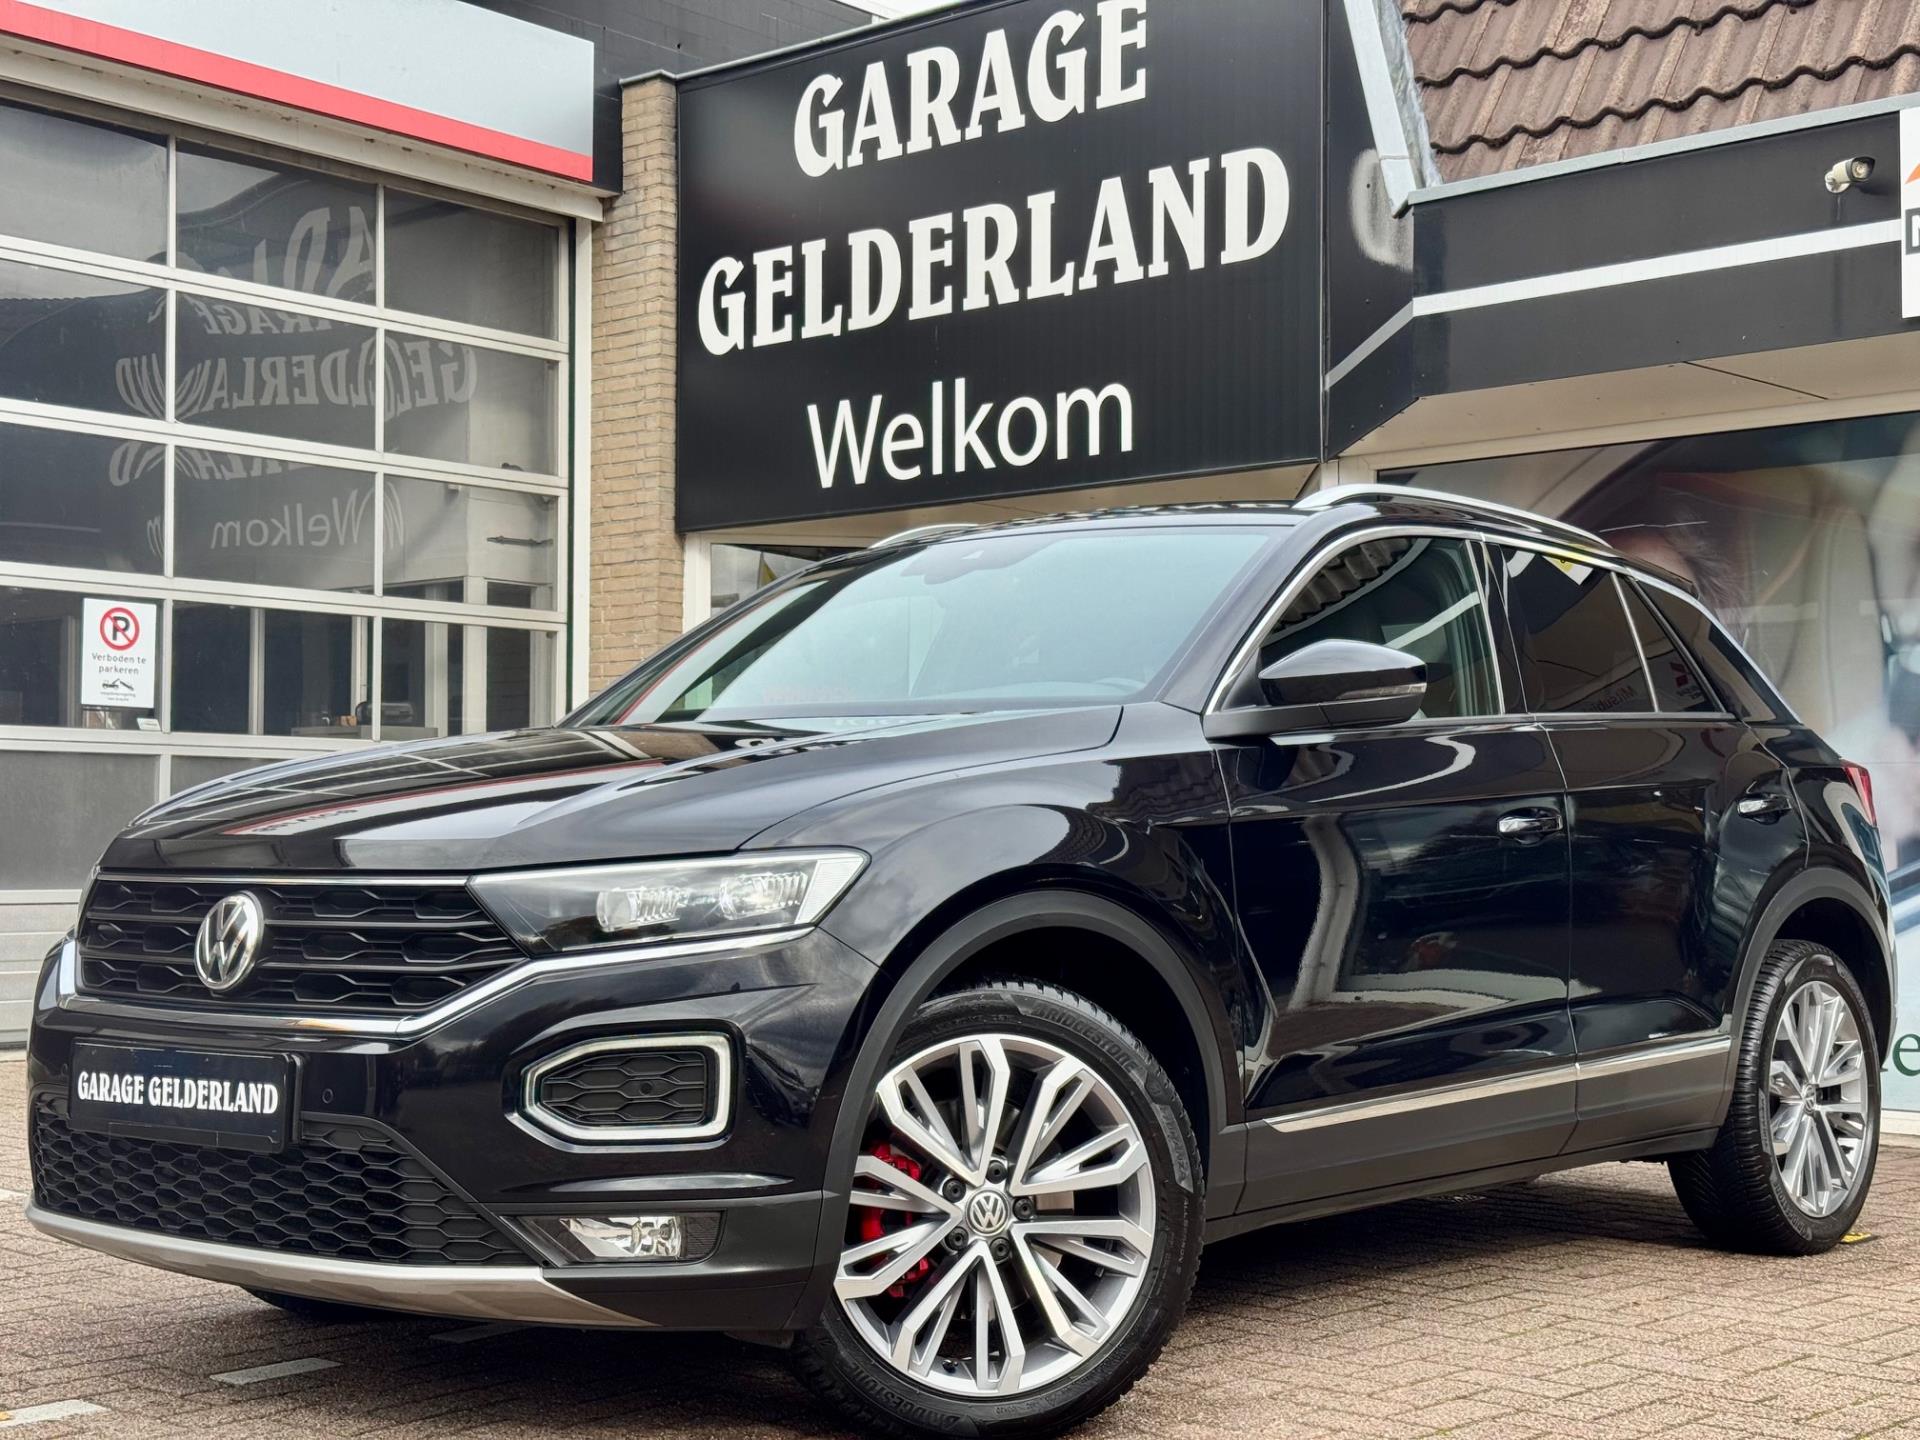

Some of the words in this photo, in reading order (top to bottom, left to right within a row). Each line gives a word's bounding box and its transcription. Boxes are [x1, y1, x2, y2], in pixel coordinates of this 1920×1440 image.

[793, 0, 1147, 178] GARAGE
[697, 146, 1290, 356] GELDERLAND
[806, 377, 1134, 489] Welkom
[112, 616, 130, 640] P
[91, 652, 135, 664] Verboden
[137, 656, 147, 664] te
[98, 664, 139, 675] parkeren
[1031, 1003, 1140, 1072] BRIDGESTONE
[77, 1070, 144, 1105] GARAGE
[148, 1076, 279, 1114] GELDERLAND
